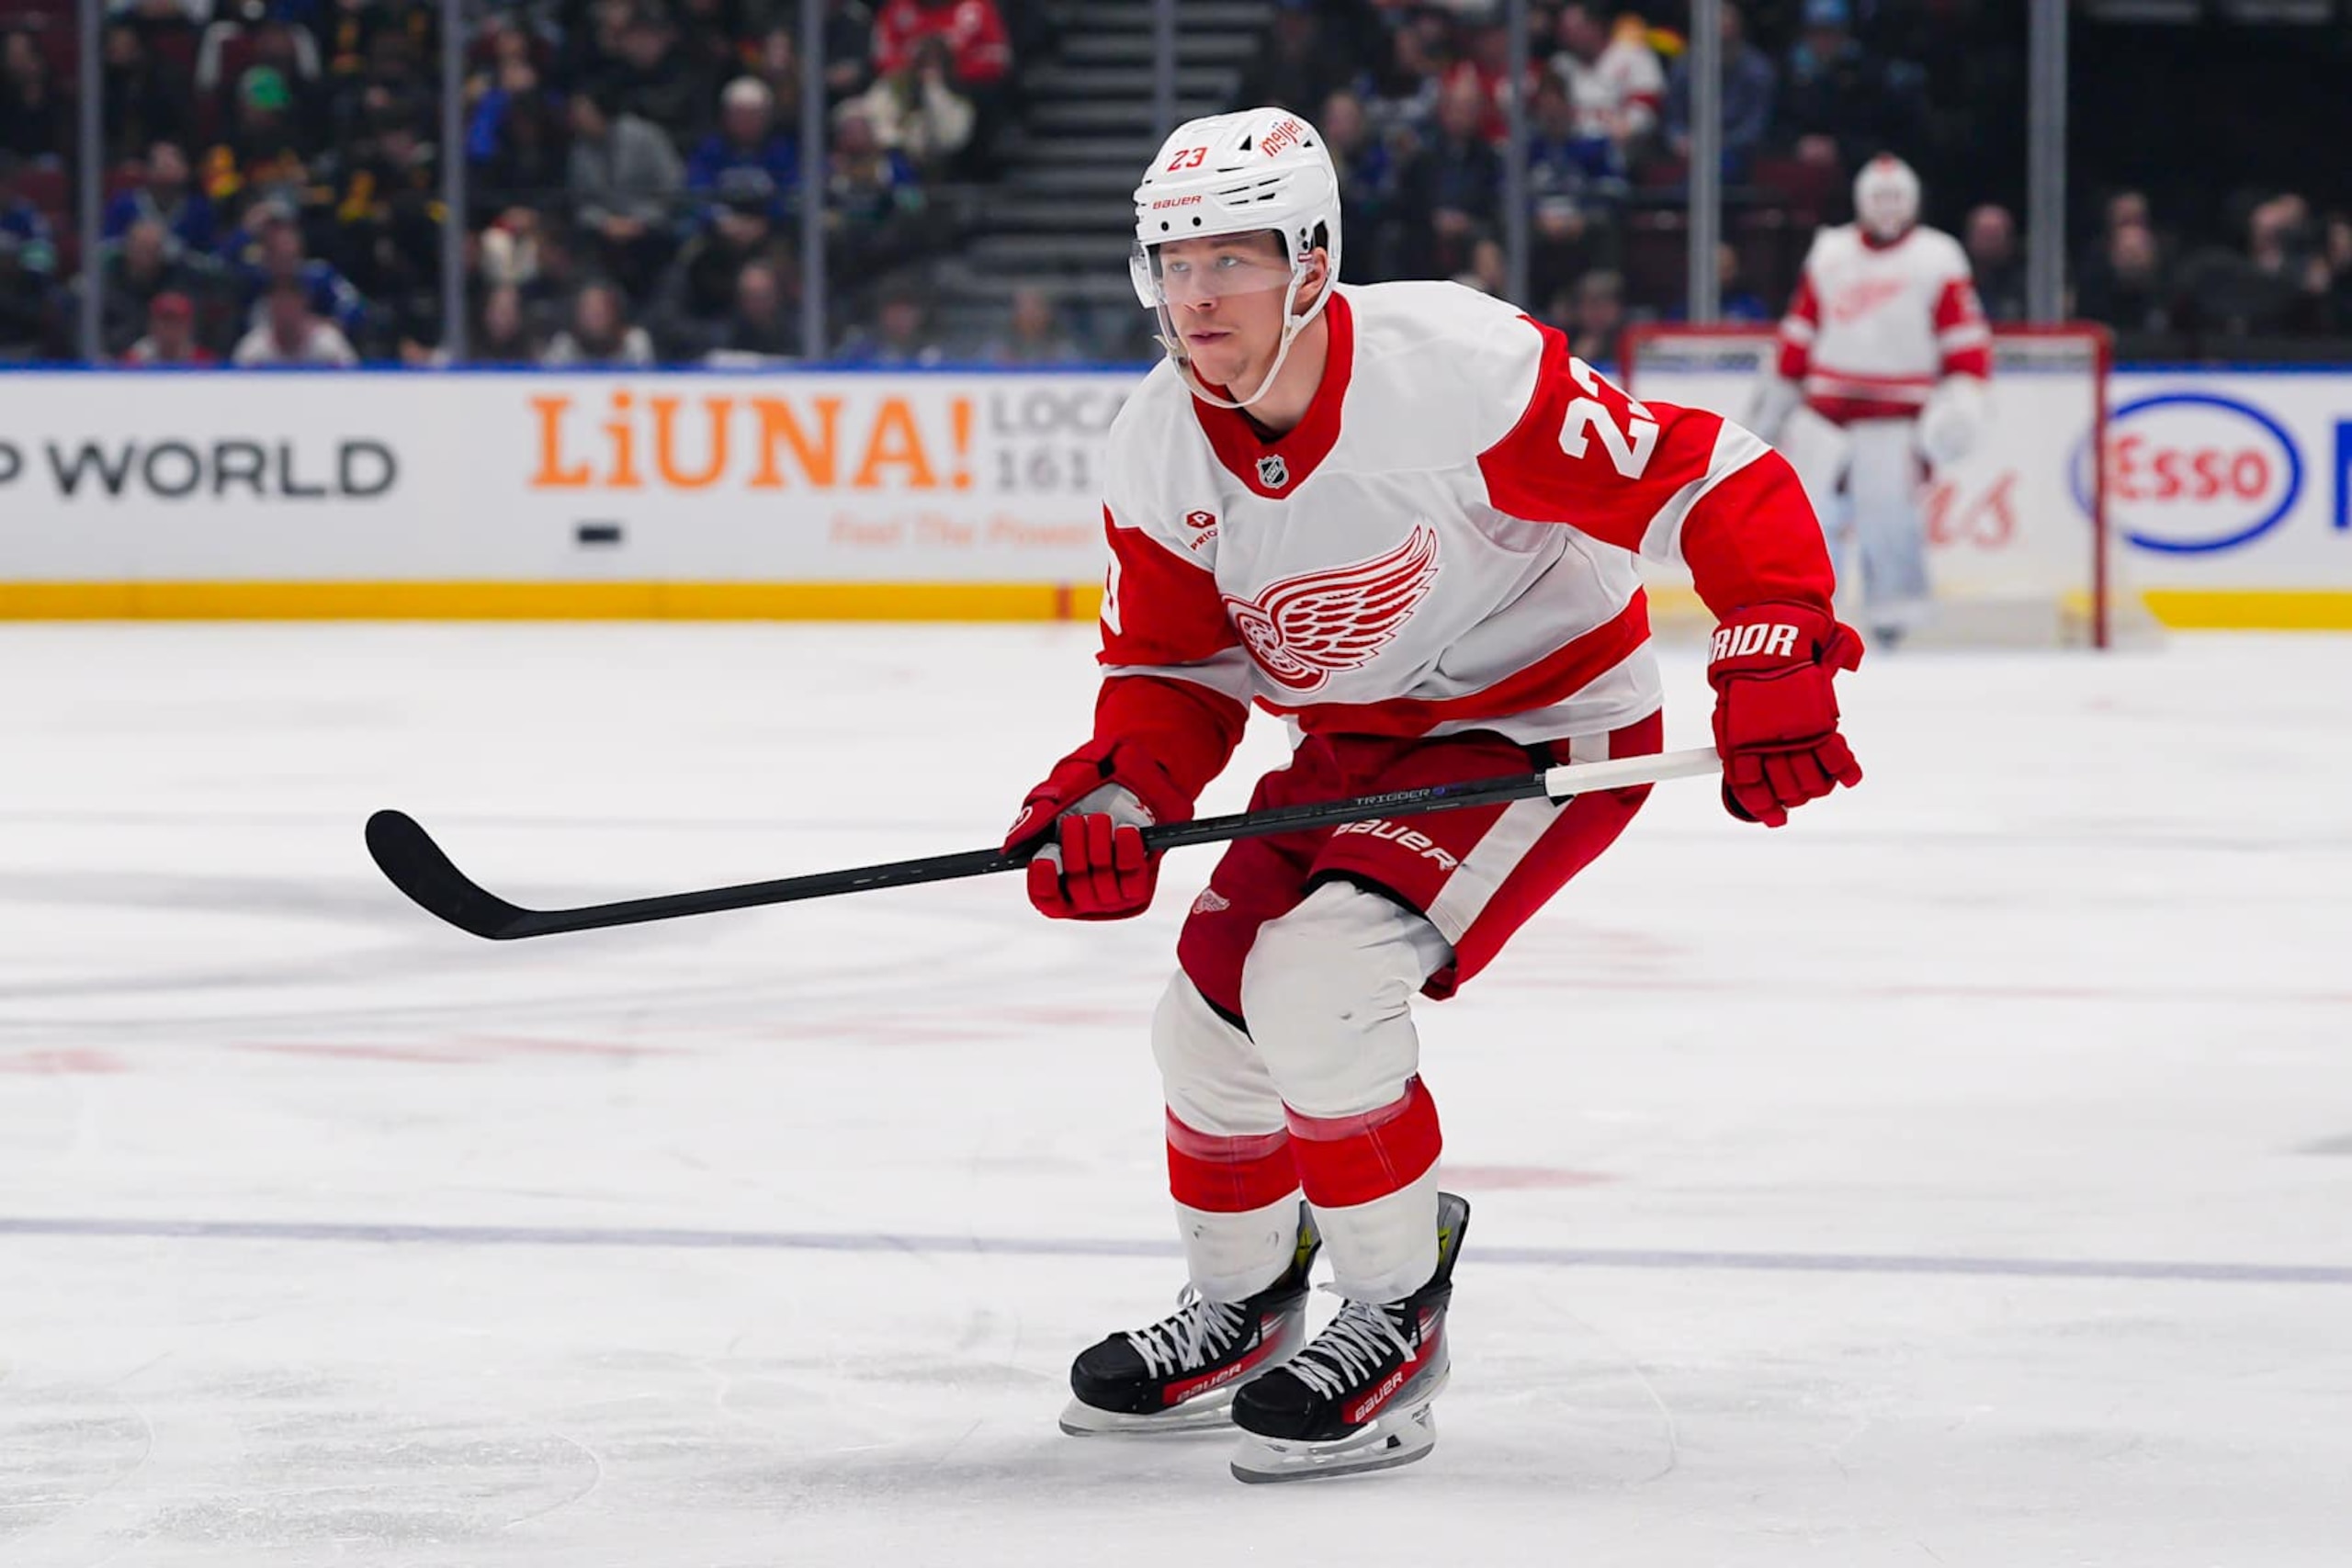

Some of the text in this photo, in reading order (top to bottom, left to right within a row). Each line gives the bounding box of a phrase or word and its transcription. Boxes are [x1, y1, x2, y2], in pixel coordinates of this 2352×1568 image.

[1261, 119, 1303, 157] meijer
[1167, 147, 1207, 172] 23
[1152, 196, 1202, 209] BAUER
[527, 389, 976, 490] LiUNA!
[45, 440, 399, 498] WORLD
[2108, 433, 2269, 502] Esso
[1190, 527, 1218, 550] PRIO
[1709, 624, 1799, 666] RIOR
[1355, 1371, 1403, 1422] BAUER
